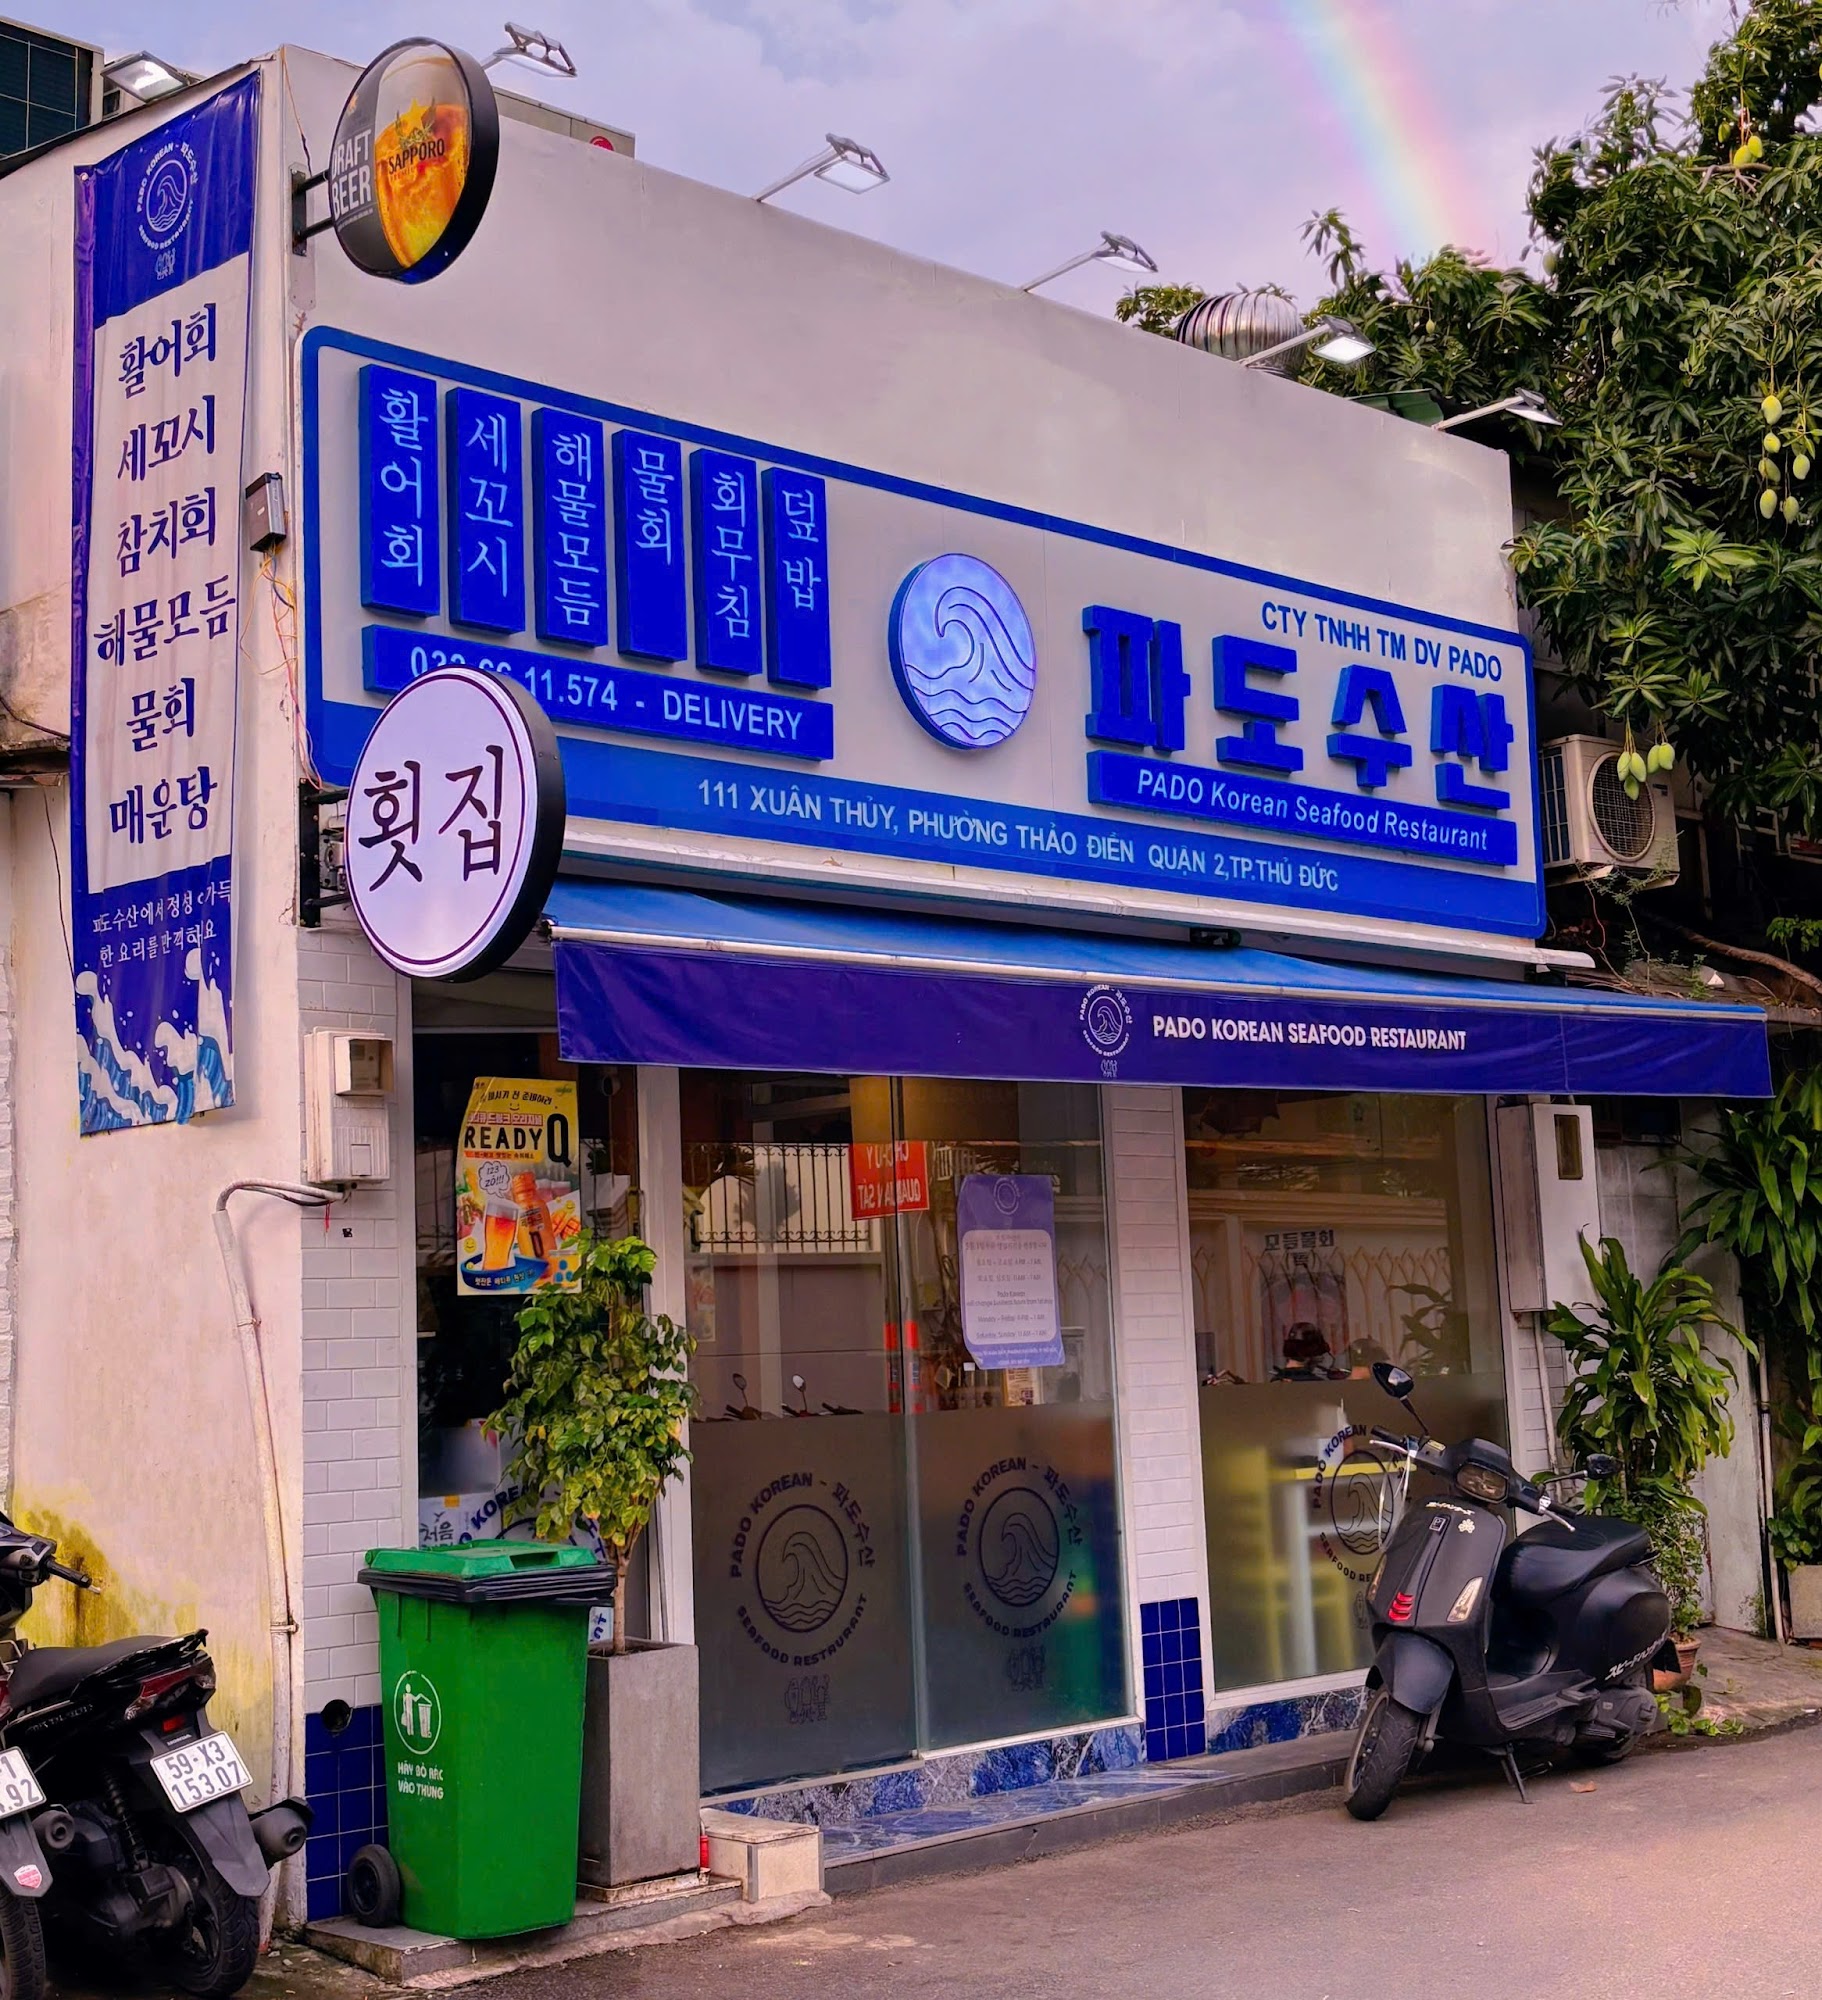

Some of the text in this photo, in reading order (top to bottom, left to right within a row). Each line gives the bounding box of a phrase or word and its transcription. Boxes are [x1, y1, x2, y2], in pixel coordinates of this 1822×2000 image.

[146, 142, 174, 176] KOREAN
[331, 165, 372, 221] BEER
[388, 138, 445, 175] SAPPORO
[118, 302, 216, 399] 활어회
[117, 395, 215, 482] 세꼬시
[379, 388, 429, 587] 활어회
[465, 413, 514, 597] 세꼬시
[552, 433, 600, 626] 해물모듬
[632, 447, 675, 566] 물회
[116, 486, 215, 577] 참치회
[711, 471, 753, 639] 회무침
[782, 489, 822, 612] 덮밥
[94, 575, 236, 666] 해물모듬
[1262, 601, 1502, 682] CTY TNHH TM DV PADO
[126, 677, 195, 752] 물회
[663, 689, 803, 740] DELIVERY
[1083, 604, 1514, 811] 파도수산
[109, 766, 218, 844] 매운탕
[359, 745, 503, 891] 횟집
[699, 779, 738, 809] 111
[750, 784, 822, 821] XUÂN
[908, 809, 1008, 846] PHƯỜNG
[1015, 822, 1077, 855] THẢO
[1148, 844, 1206, 876] QUẬN
[1299, 858, 1339, 892] ĐỨC
[1137, 768, 1488, 851] PADO Korean Seafood Restaurant
[1153, 1015, 1467, 1050] PADO KOREAN SEAFOOD RESTAURANT
[464, 1113, 572, 1168] READY Q
[956, 1499, 975, 1556] PADO
[972, 1457, 1027, 1497] KOREAN
[1044, 1466, 1083, 1545] 파도수산
[1312, 1424, 1367, 1509] PADO KOREAN
[730, 1517, 752, 1578] PADO
[750, 1472, 813, 1514] KOREAN
[832, 1482, 876, 1568] 파도수산
[1319, 1531, 1356, 1581] SEAFOOD
[737, 1593, 867, 1666] SEAFOOD RESTAURANT
[963, 1570, 1077, 1638] SEAFOOD RESTAURANT
[164, 1740, 226, 1779] 59-X3
[171, 1760, 241, 1806] 153.07
